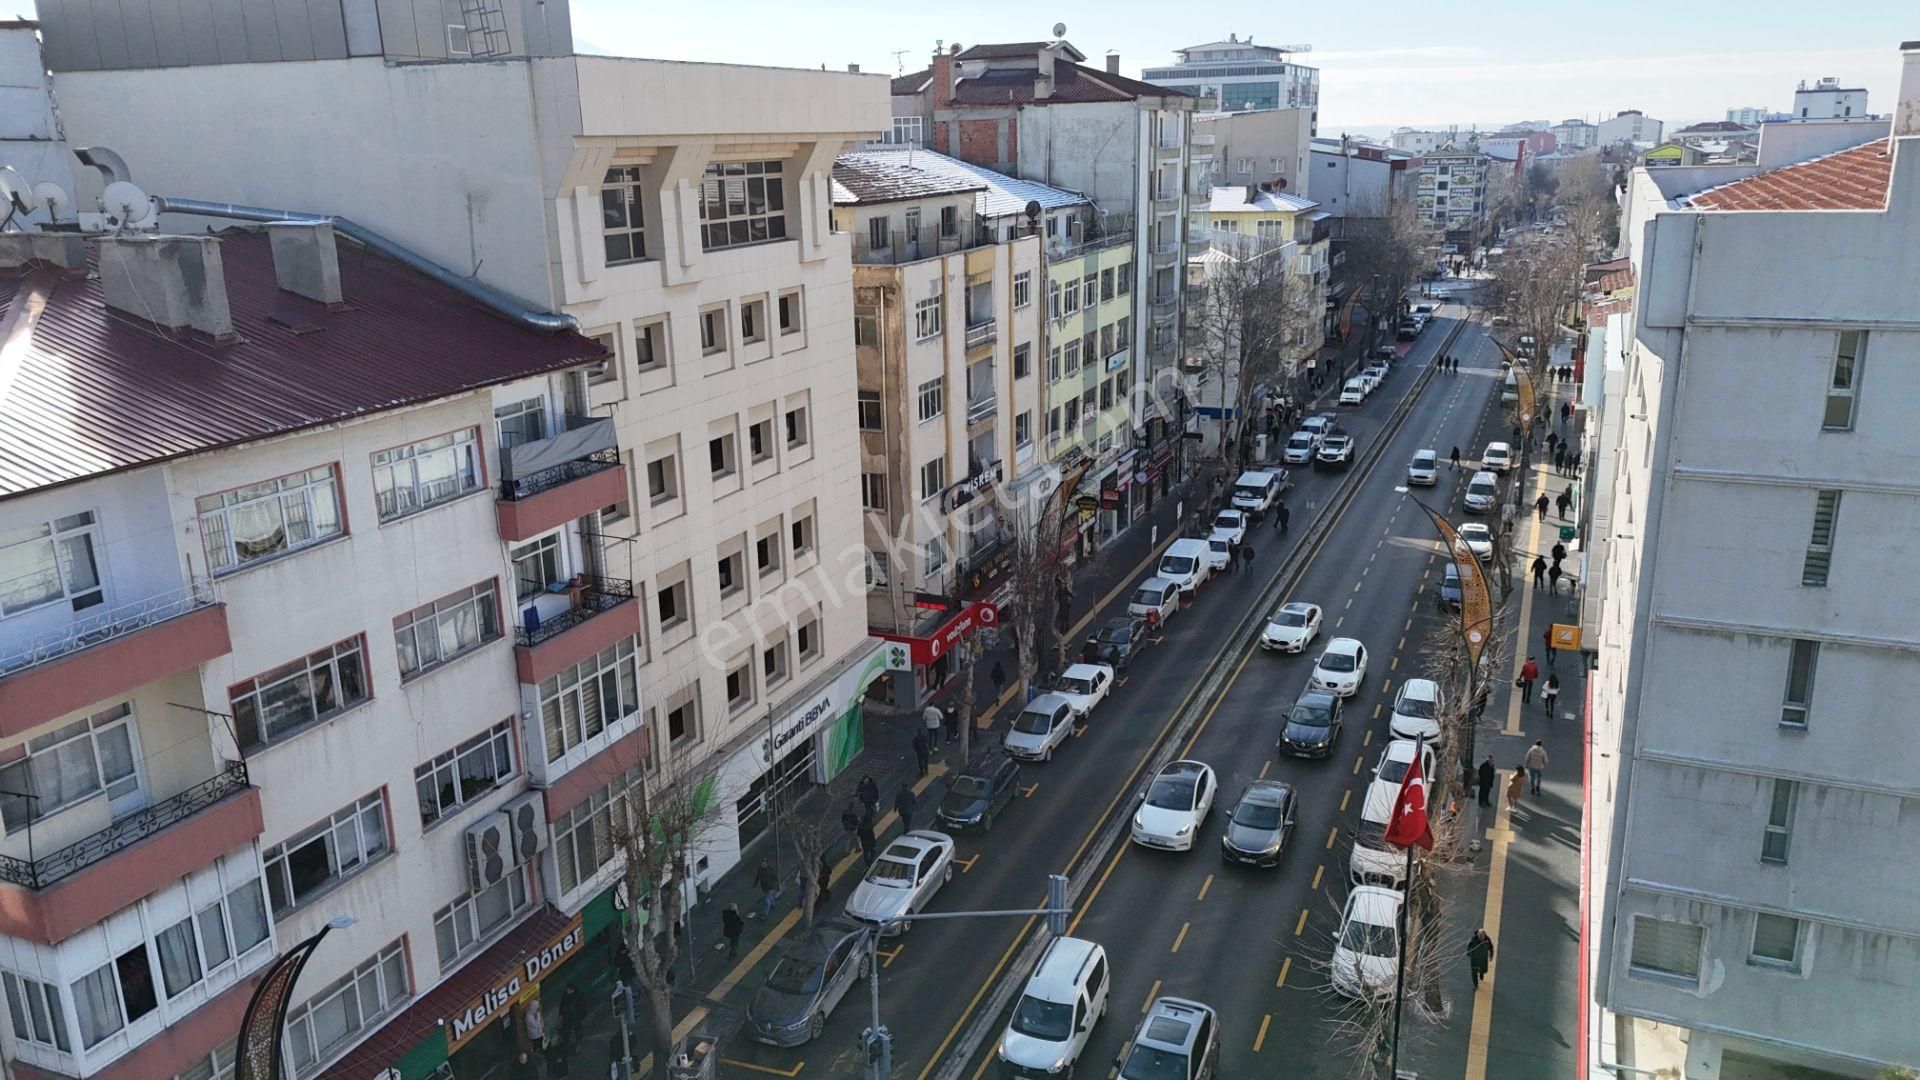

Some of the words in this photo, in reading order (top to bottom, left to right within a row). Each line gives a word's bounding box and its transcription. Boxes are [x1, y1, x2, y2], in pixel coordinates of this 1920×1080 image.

[946, 616, 972, 643] vodafone
[774, 716, 805, 750] Garanti
[805, 697, 831, 728] BBVA
[452, 976, 521, 1041] Melisa
[524, 926, 582, 982] Döner
